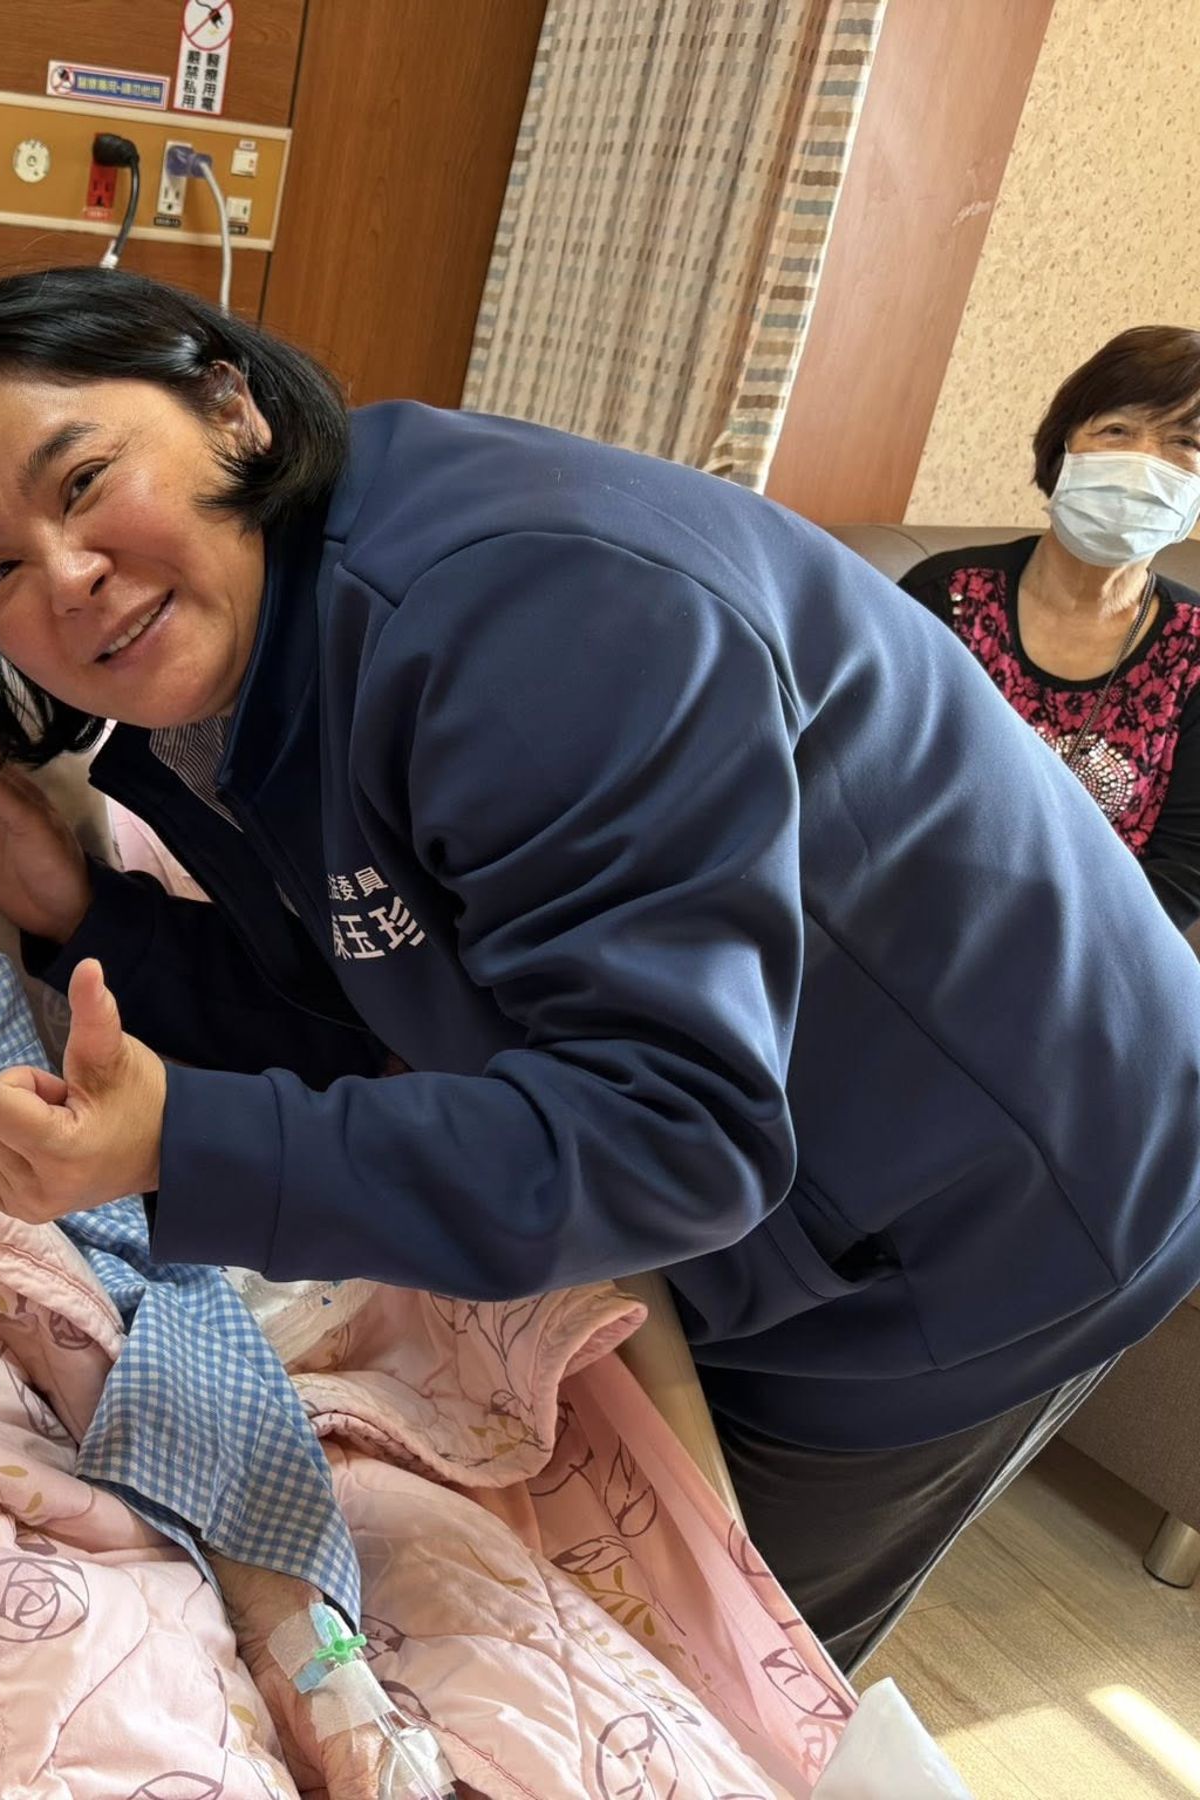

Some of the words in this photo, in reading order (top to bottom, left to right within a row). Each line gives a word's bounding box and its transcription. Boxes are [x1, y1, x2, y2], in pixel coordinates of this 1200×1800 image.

[181, 50, 201, 109] 嚴禁私用
[201, 52, 220, 111] 醫療用電
